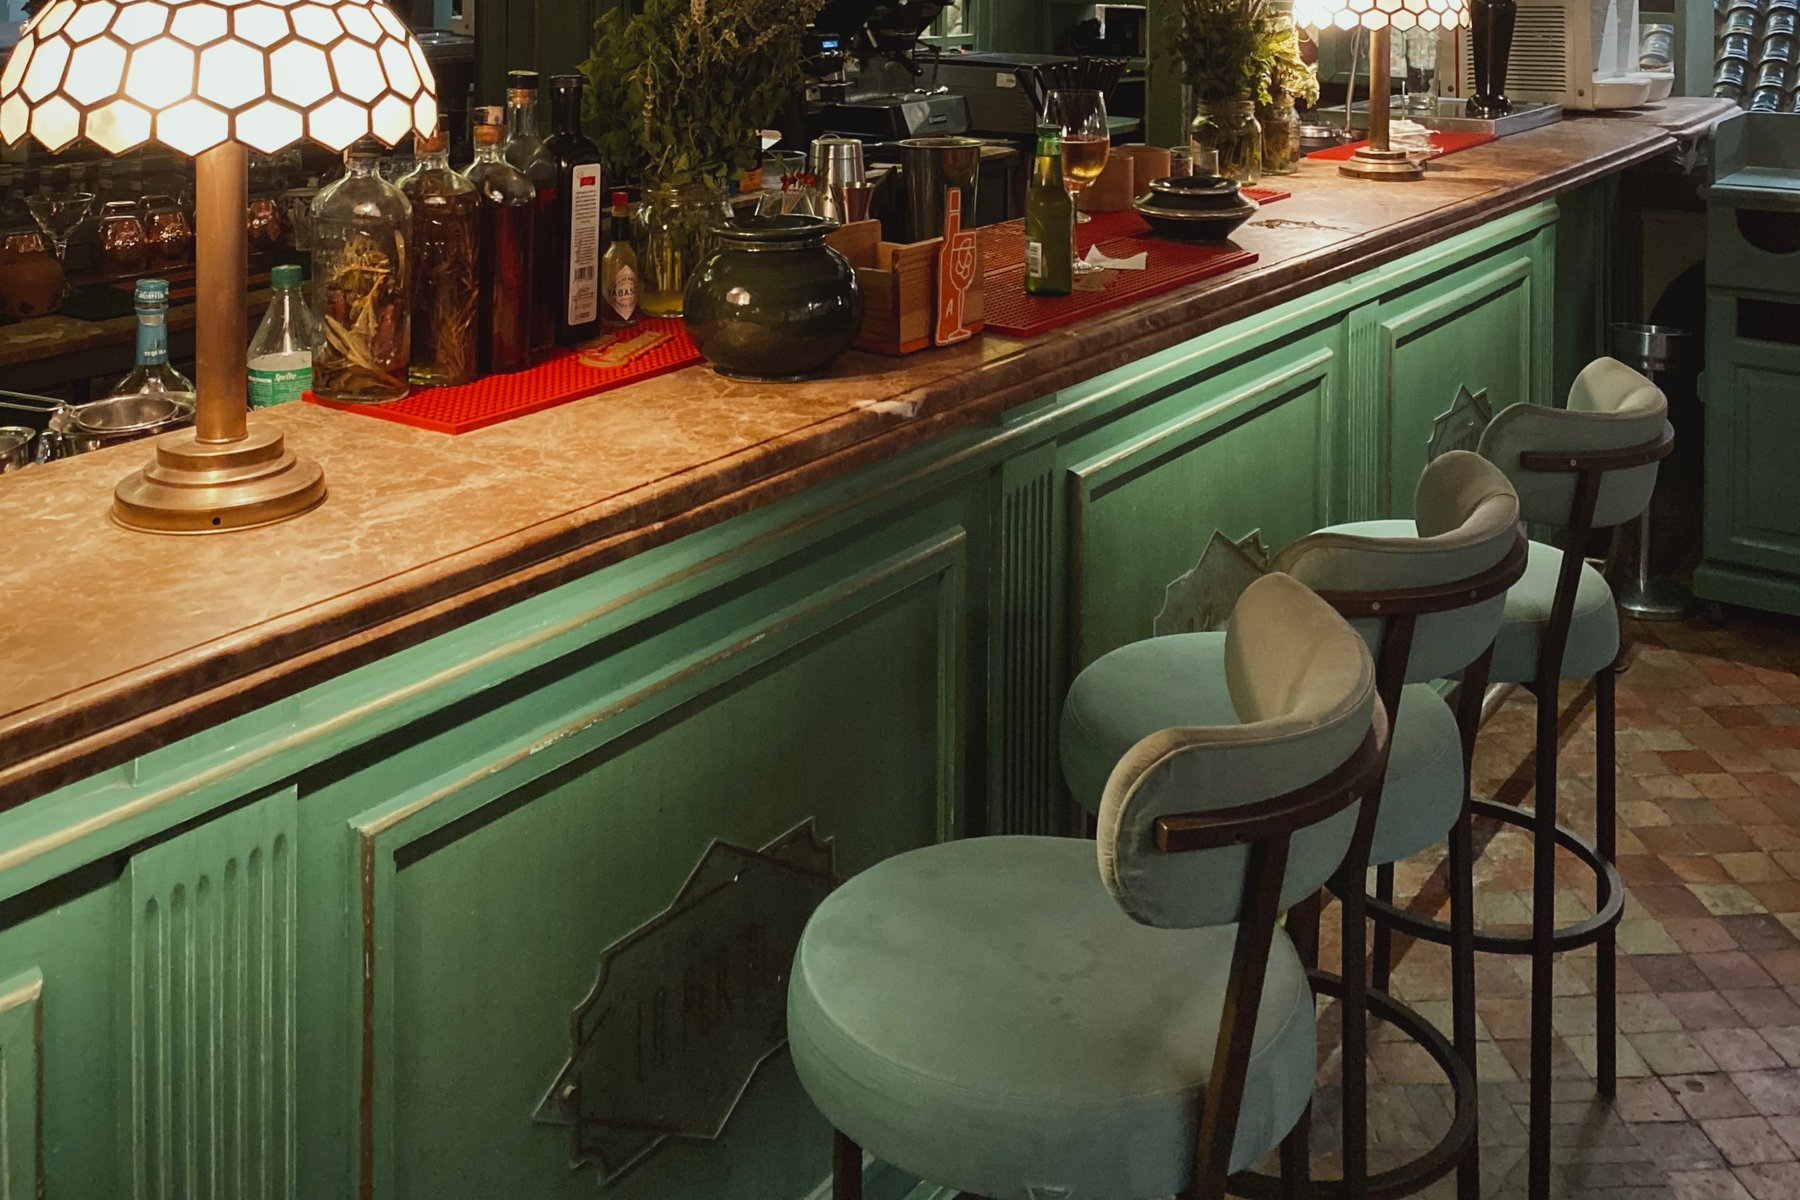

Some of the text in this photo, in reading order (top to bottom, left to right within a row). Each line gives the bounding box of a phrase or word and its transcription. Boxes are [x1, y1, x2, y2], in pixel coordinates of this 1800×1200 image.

[607, 287, 636, 297] TABAS
[945, 298, 954, 318] A
[144, 349, 167, 357] TEQUILA
[275, 372, 297, 383] Sprite
